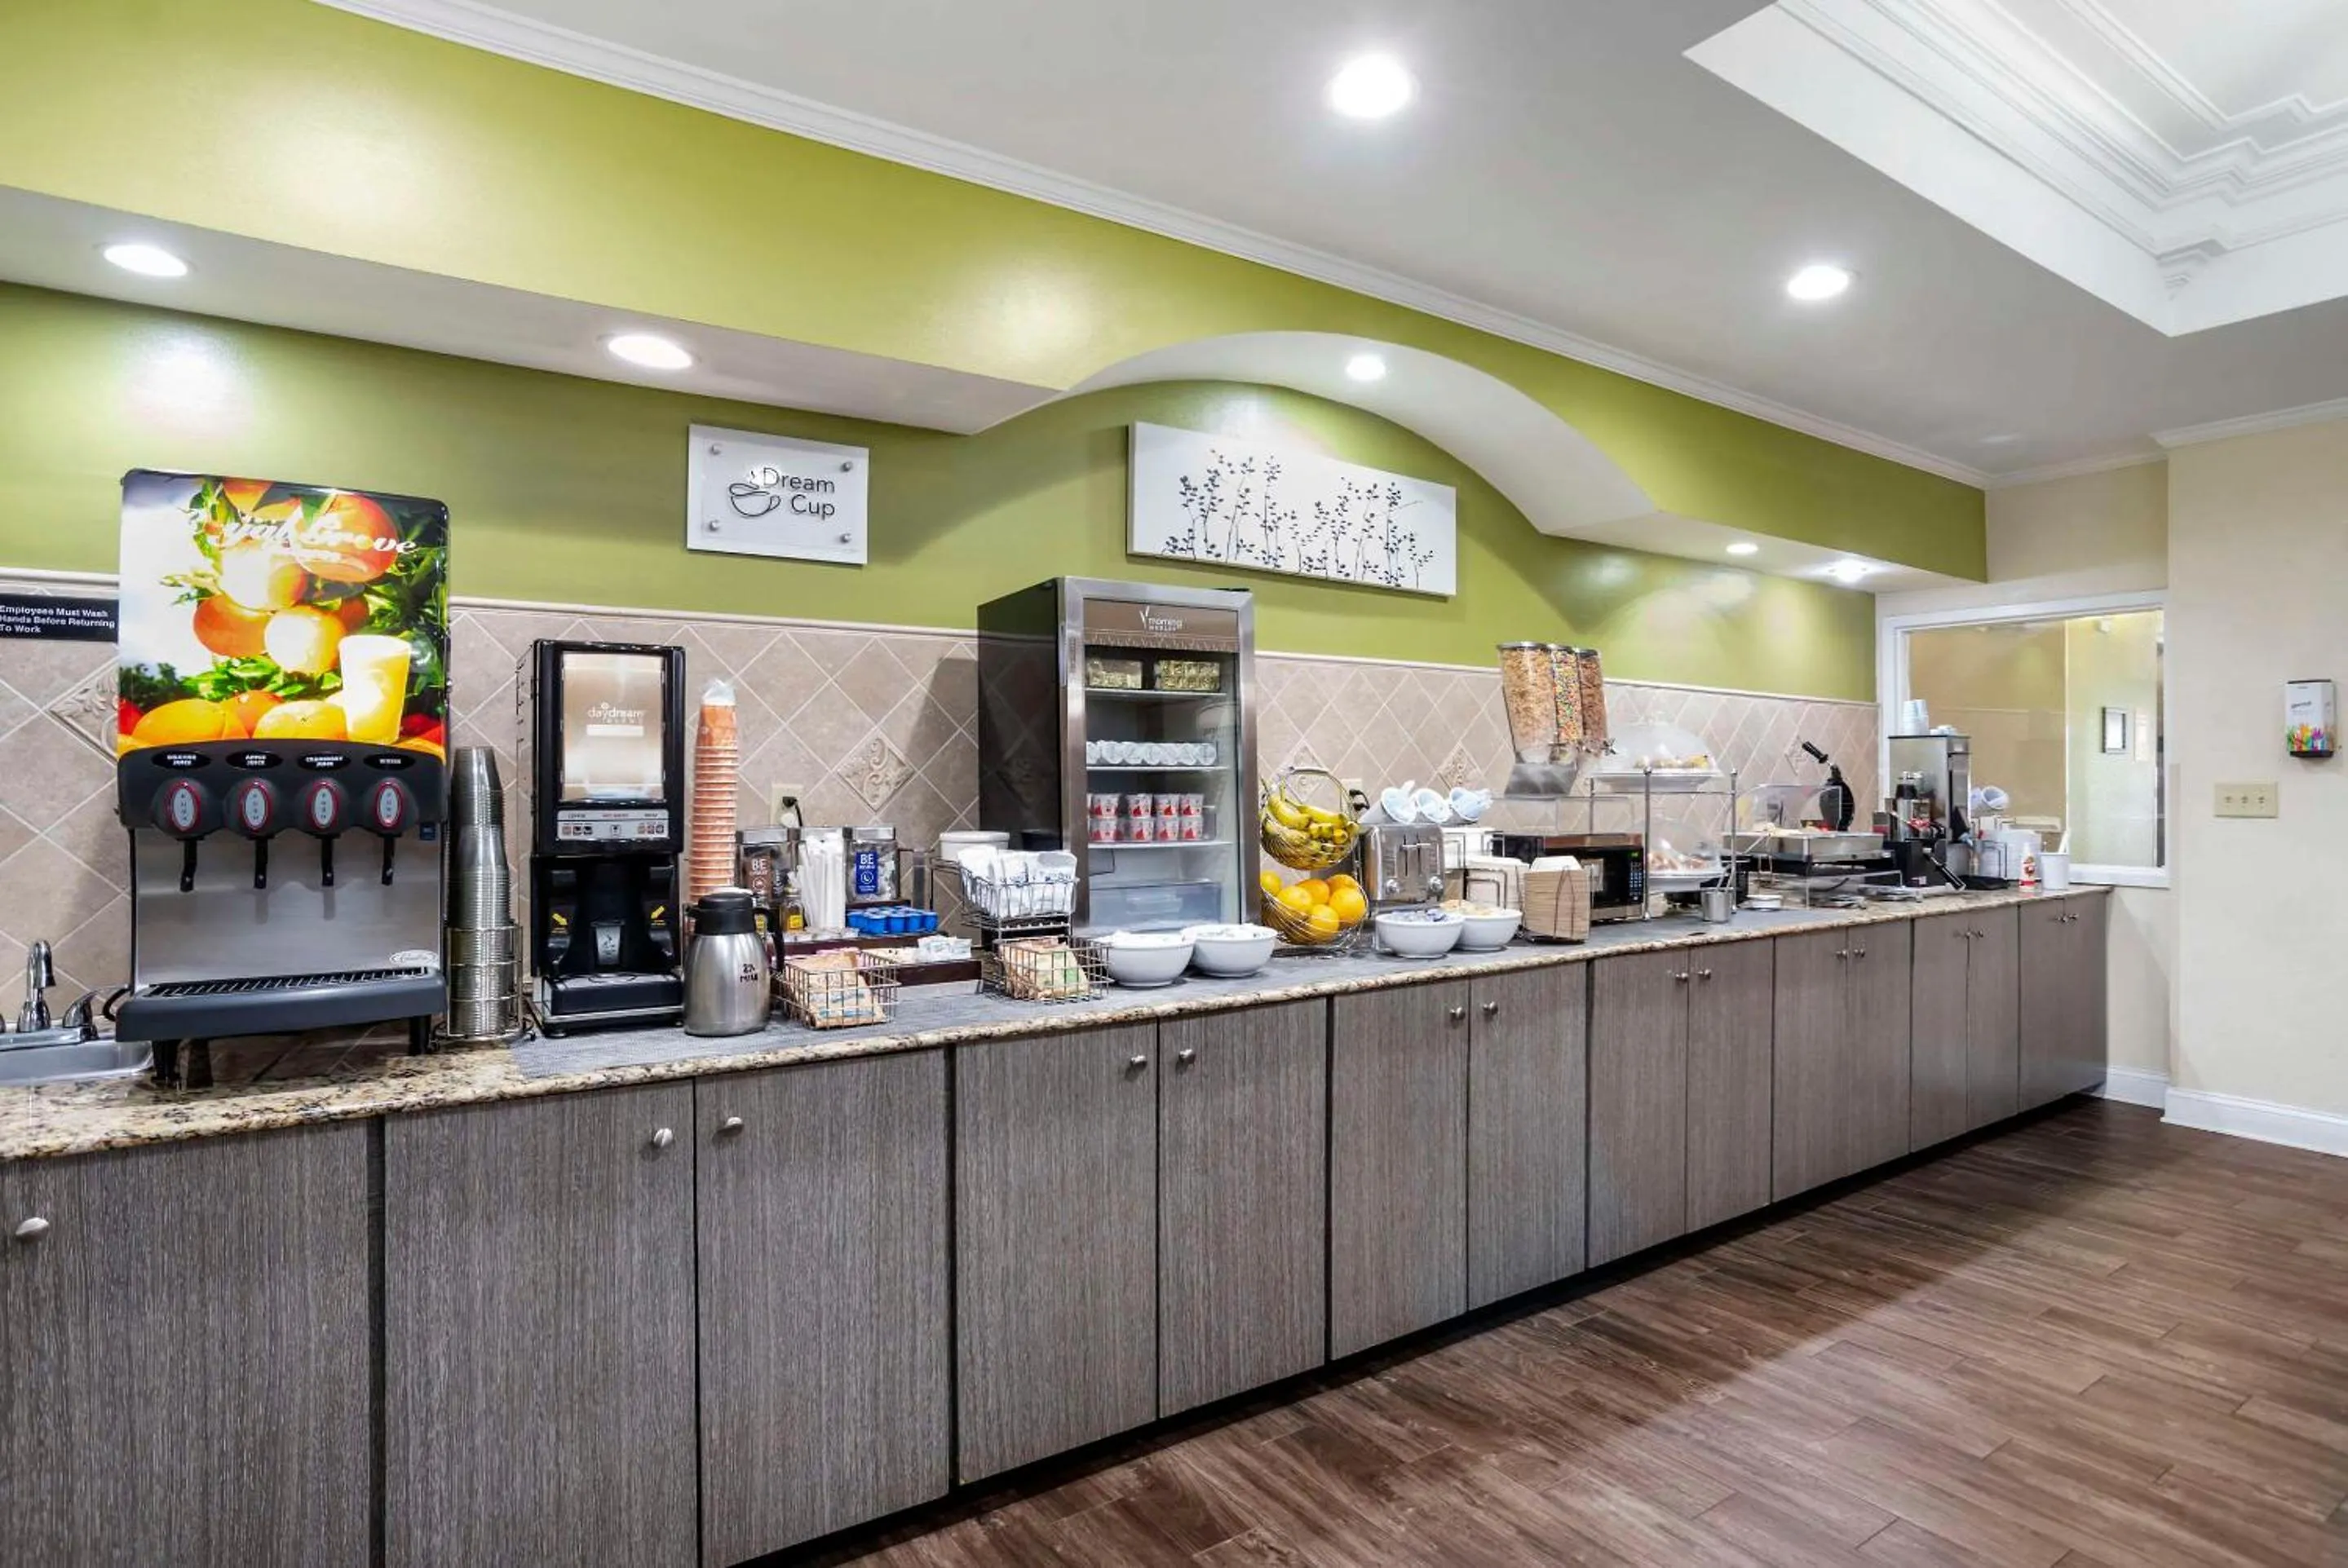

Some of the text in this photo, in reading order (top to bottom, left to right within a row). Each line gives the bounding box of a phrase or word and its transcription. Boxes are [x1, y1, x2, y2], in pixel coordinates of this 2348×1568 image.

[763, 467, 835, 493] Dream
[791, 493, 835, 520] Cup
[0, 605, 108, 617] Employees Must Wash
[0, 615, 116, 629] Hands Before Returning
[0, 624, 42, 633] To Work
[752, 859, 767, 871] BE
[860, 854, 874, 864] BE
